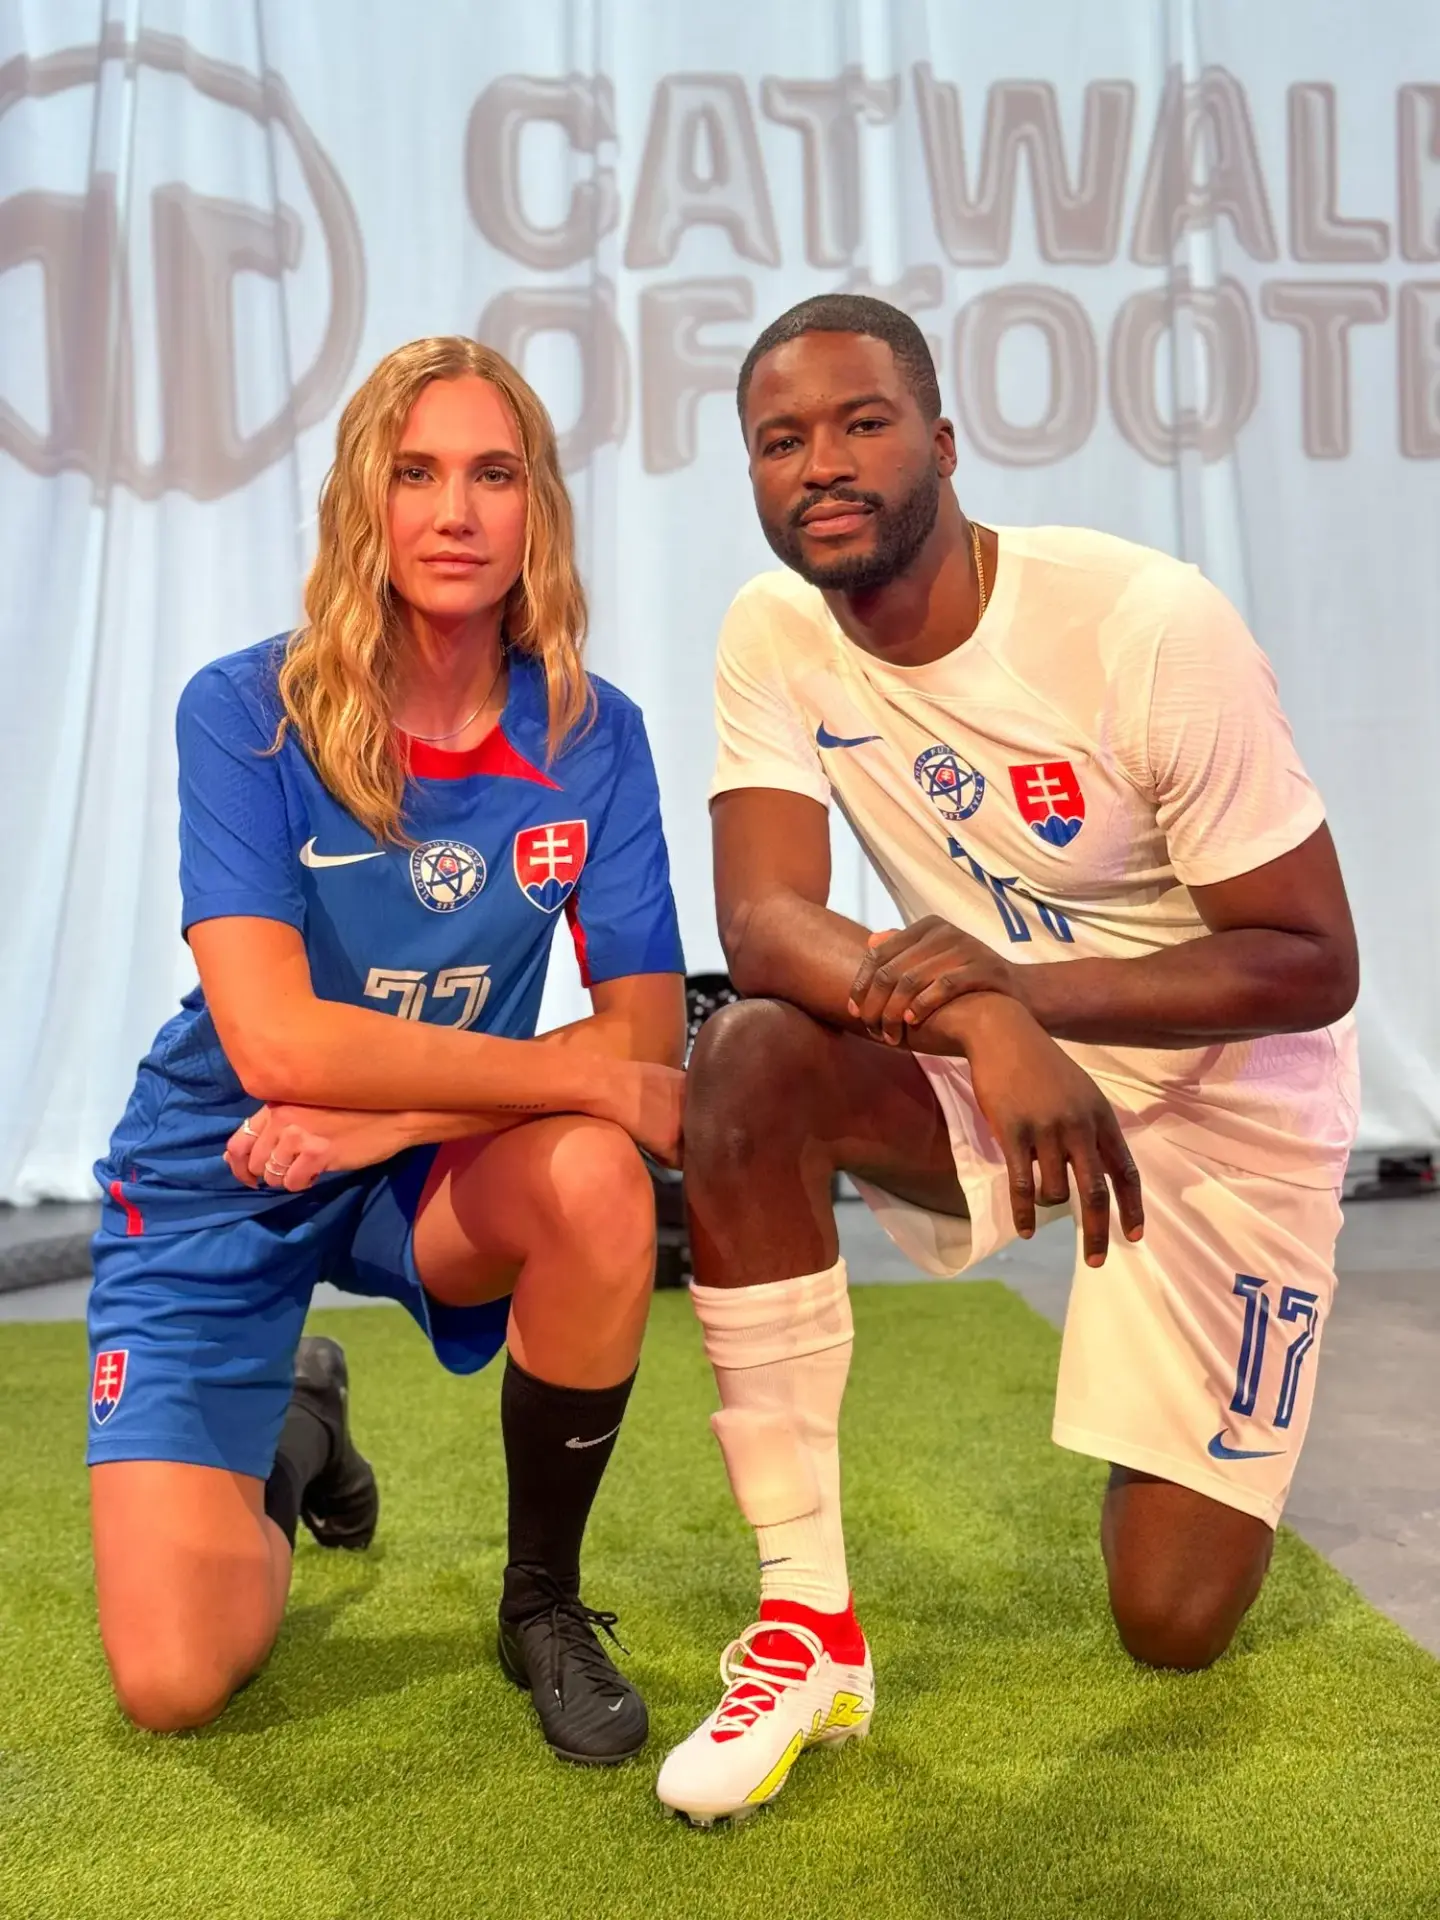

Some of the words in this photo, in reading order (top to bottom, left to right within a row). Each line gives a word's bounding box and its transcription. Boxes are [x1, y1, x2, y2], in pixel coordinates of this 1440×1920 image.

[474, 273, 754, 477] OF
[838, 266, 1440, 467] OOT
[1230, 1273, 1319, 1429] 17
